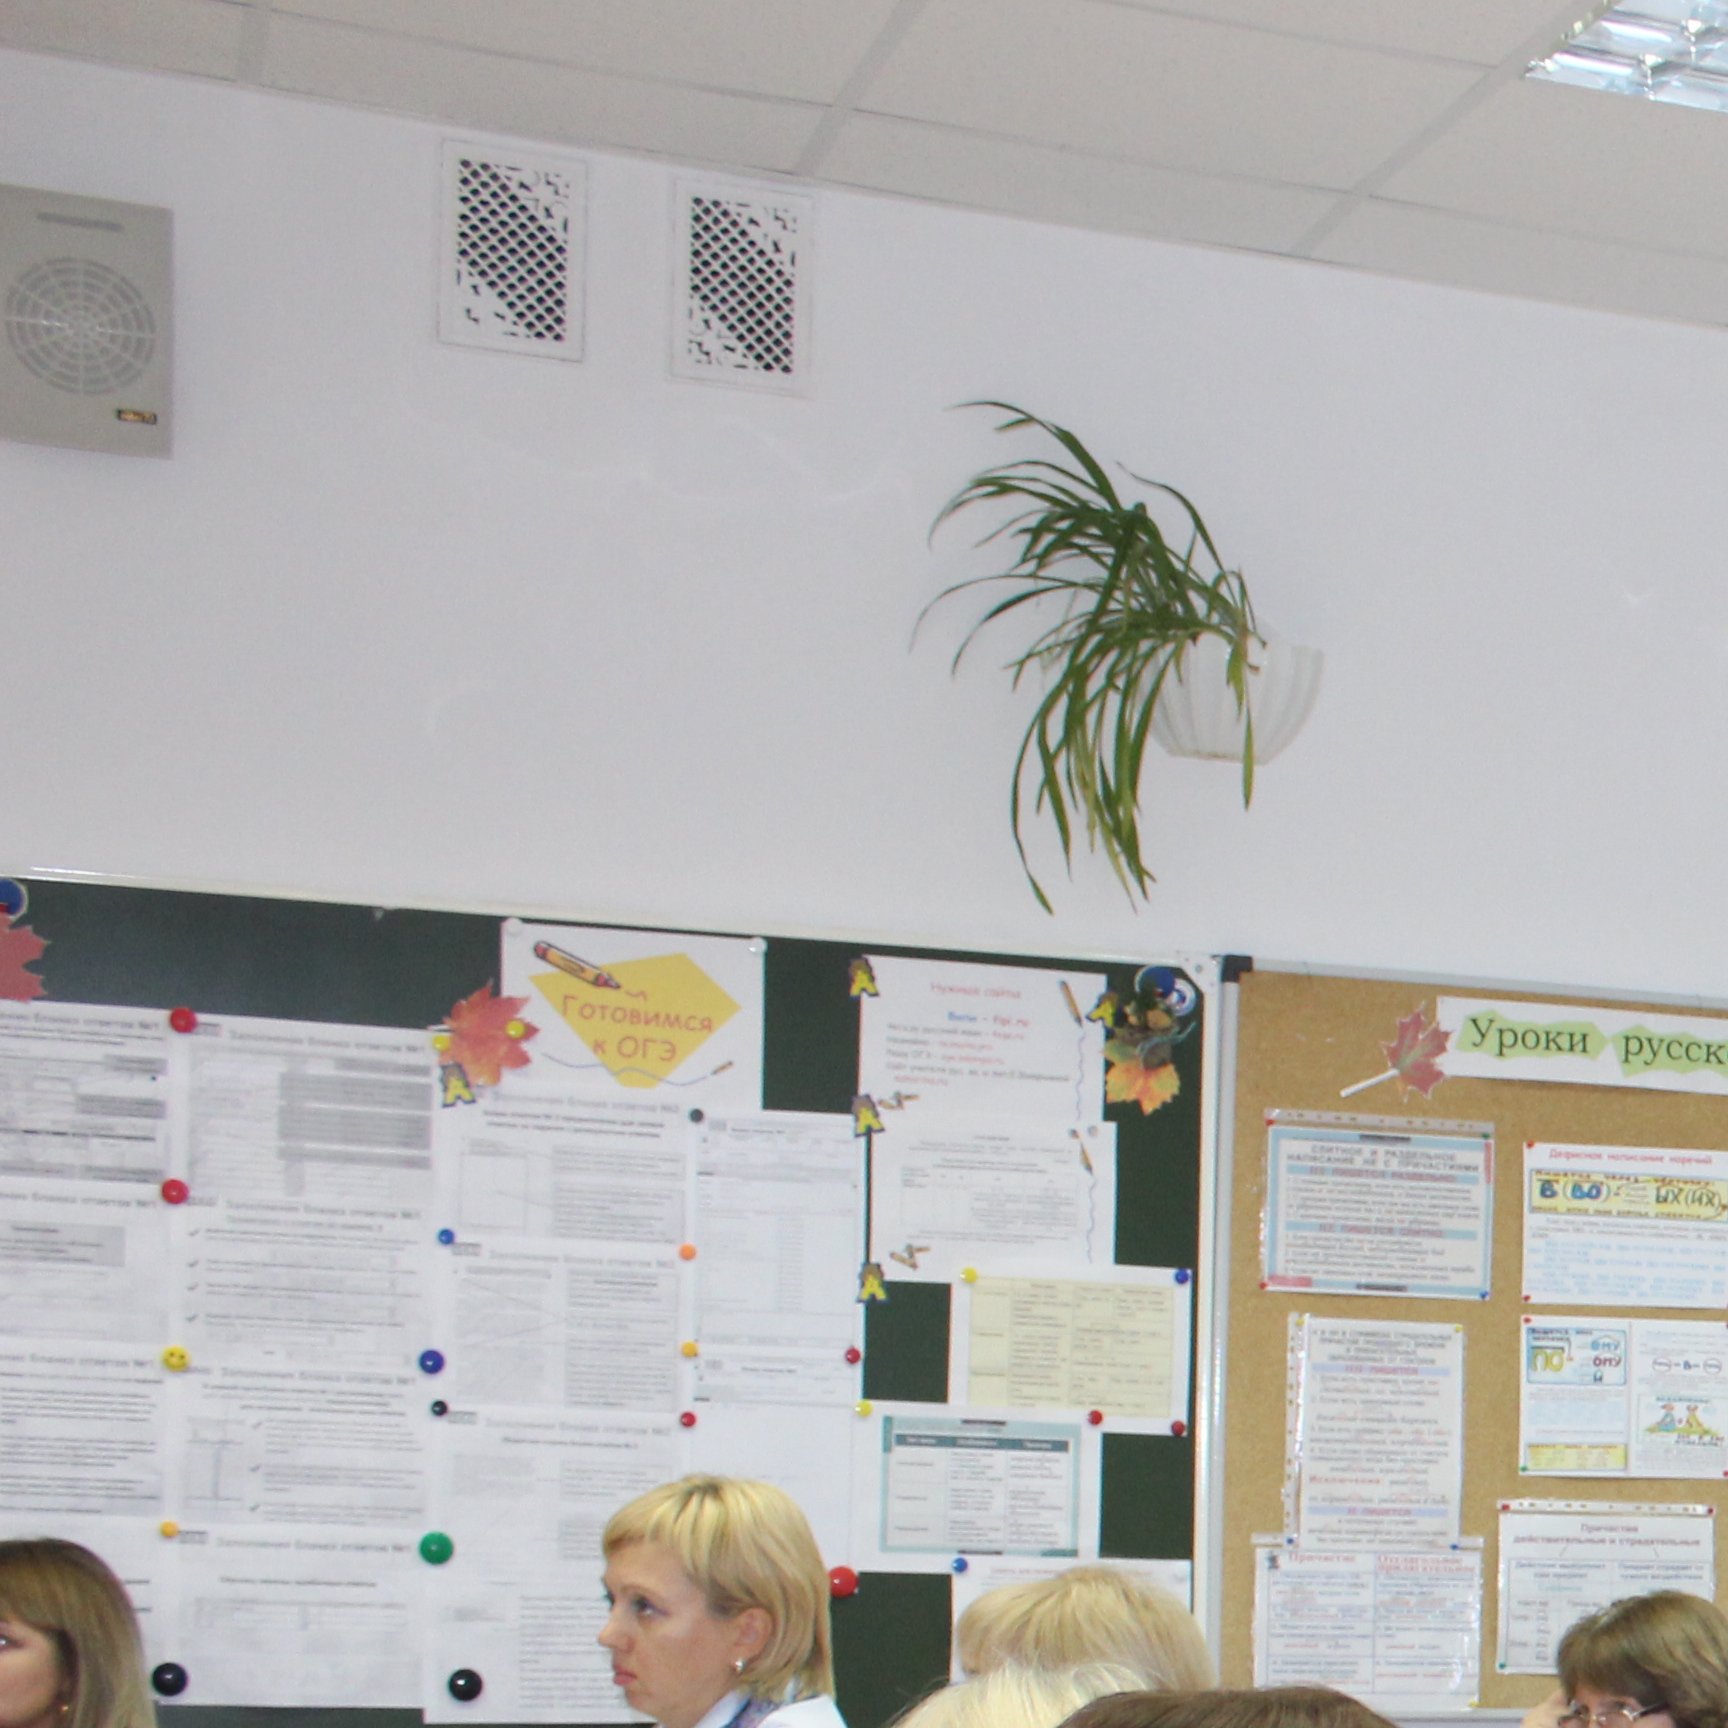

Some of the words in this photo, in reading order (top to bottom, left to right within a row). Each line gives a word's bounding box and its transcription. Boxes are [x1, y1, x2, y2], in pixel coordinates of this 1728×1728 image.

[562, 995, 713, 1033] Готовимся
[593, 1040, 607, 1057] к
[617, 1038, 678, 1062] ОГЭ
[1468, 1016, 1590, 1056] Уроки
